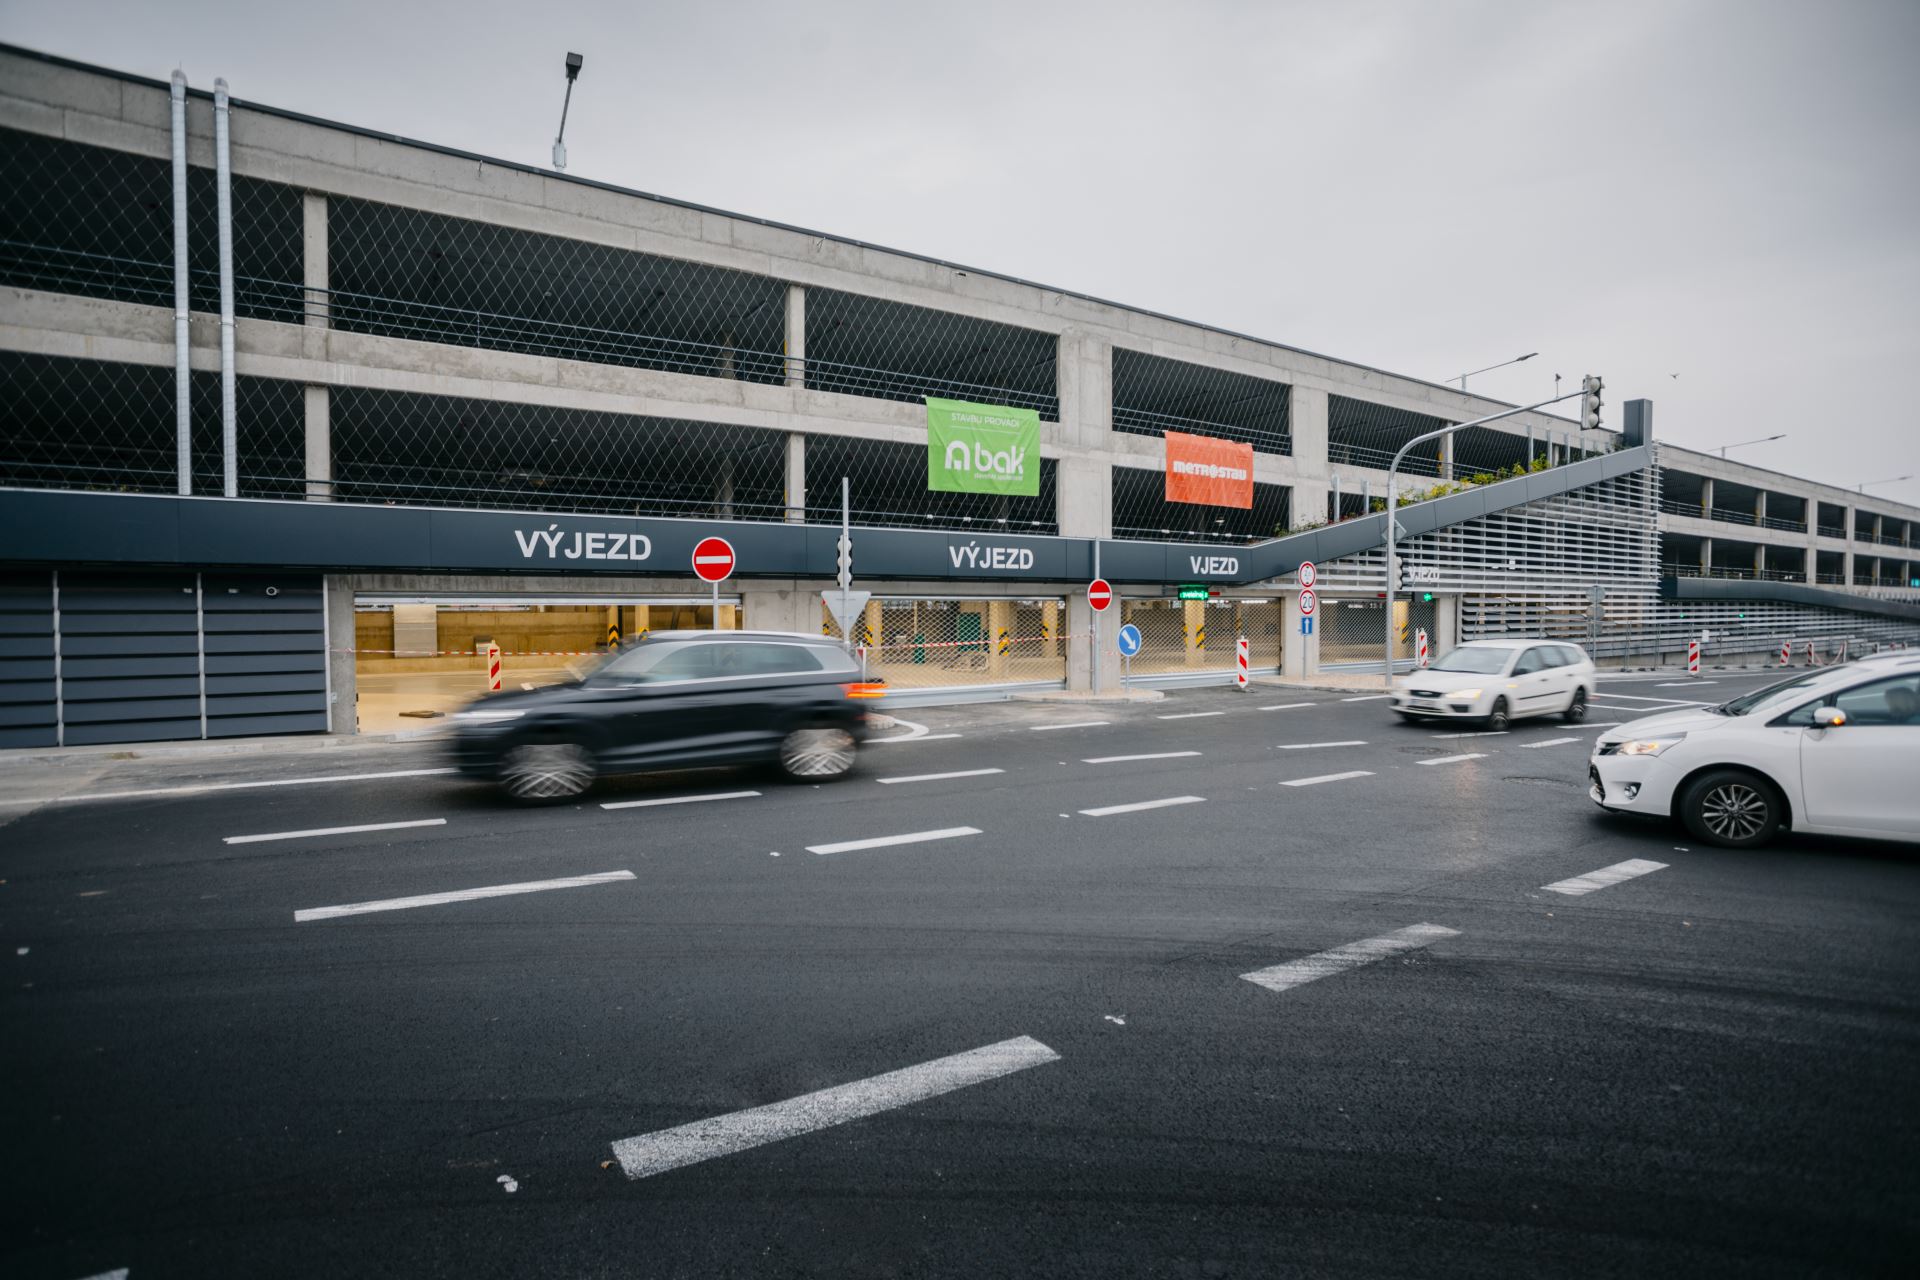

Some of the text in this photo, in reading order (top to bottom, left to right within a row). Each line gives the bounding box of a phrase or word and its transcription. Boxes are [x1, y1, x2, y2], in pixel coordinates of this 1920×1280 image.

[514, 523, 652, 561] VÝJEZD
[949, 540, 1034, 570] VÝJEZD
[1190, 555, 1239, 575] VJEZD
[1302, 596, 1313, 609] 20
